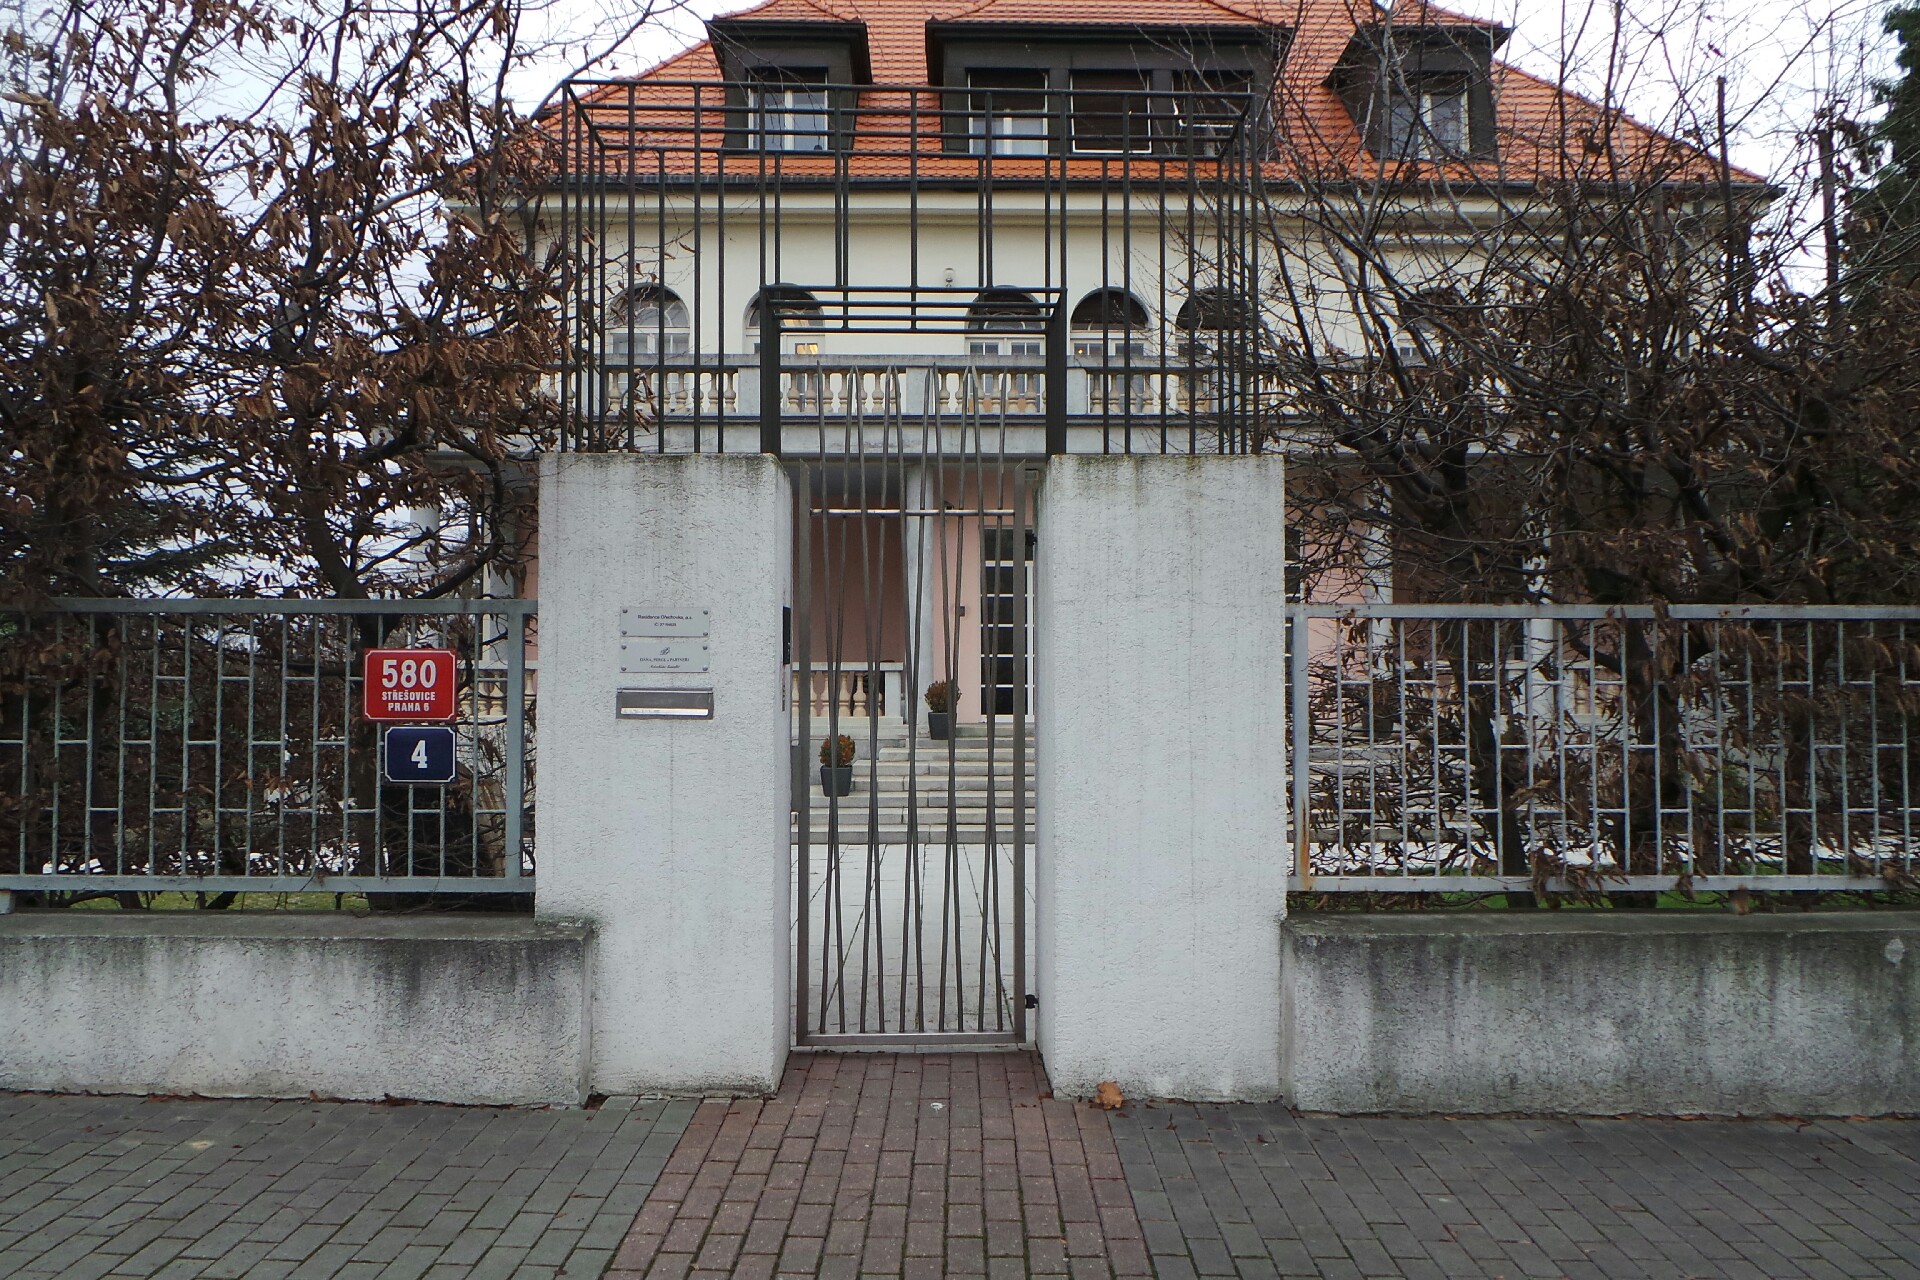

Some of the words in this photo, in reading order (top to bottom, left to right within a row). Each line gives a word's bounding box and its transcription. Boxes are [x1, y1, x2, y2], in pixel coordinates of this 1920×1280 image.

[381, 659, 437, 689] 580
[381, 689, 436, 701] STŘEŠOVICE
[388, 702, 421, 712] PRAHA
[423, 702, 430, 712] 6
[411, 739, 428, 769] 4
